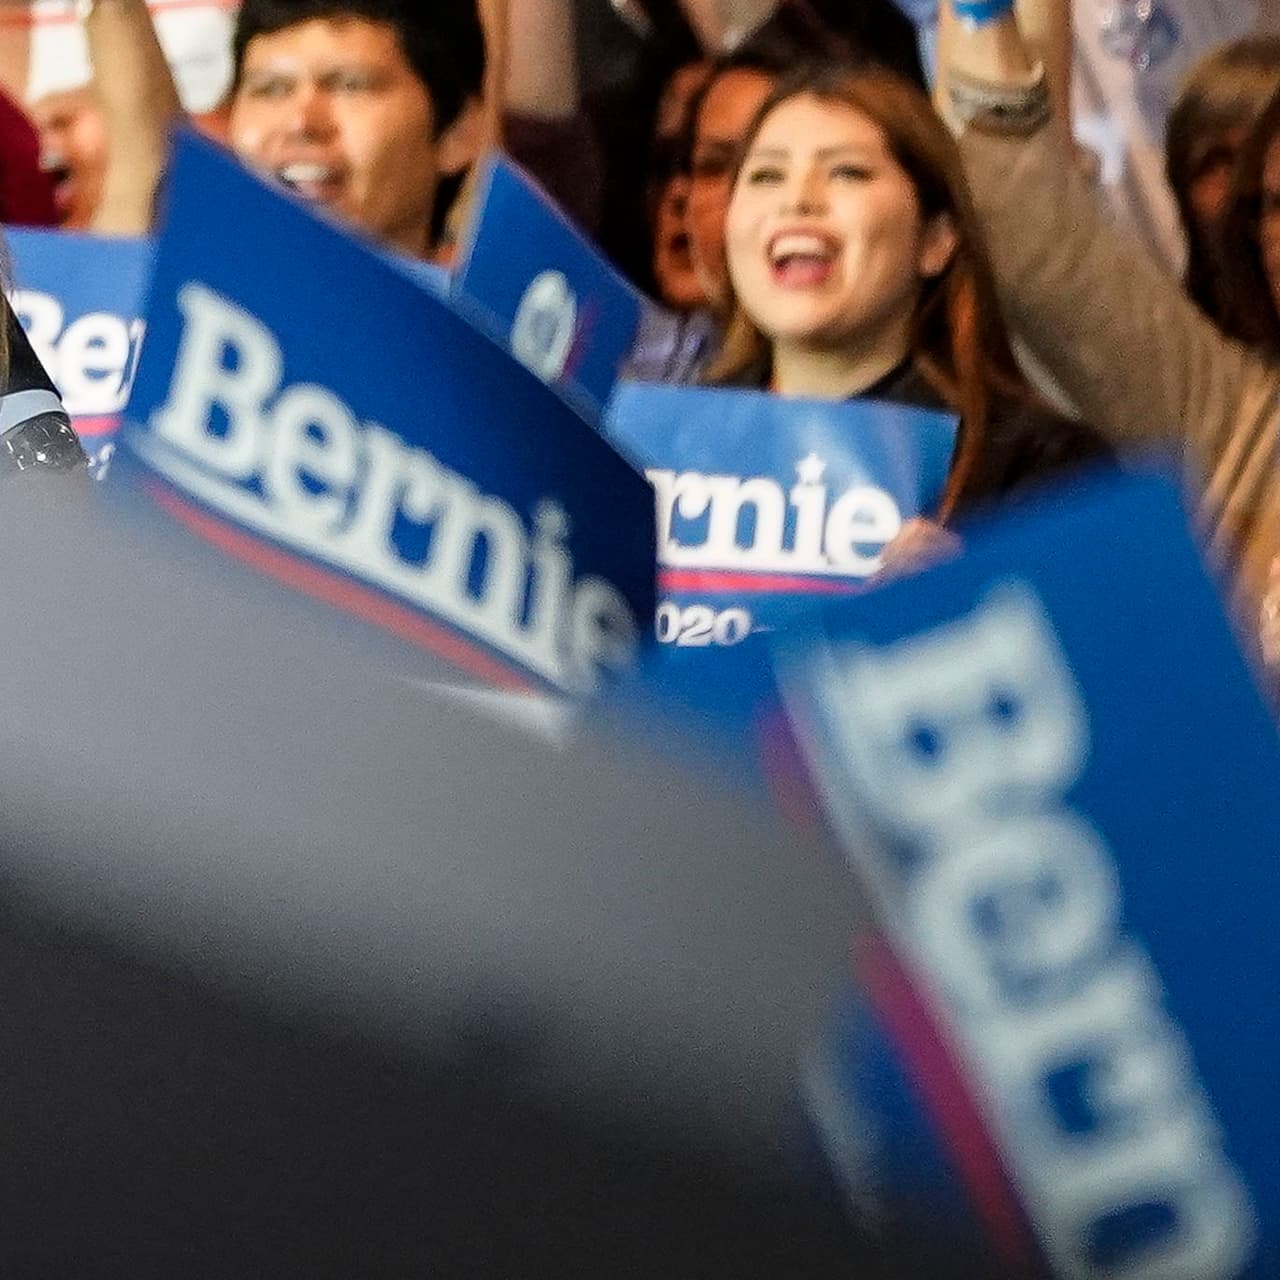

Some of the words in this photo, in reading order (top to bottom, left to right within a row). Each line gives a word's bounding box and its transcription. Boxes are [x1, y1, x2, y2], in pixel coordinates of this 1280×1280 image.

[644, 452, 902, 577] rnie
[654, 600, 752, 648] 020
[810, 575, 1260, 1280] Bern
